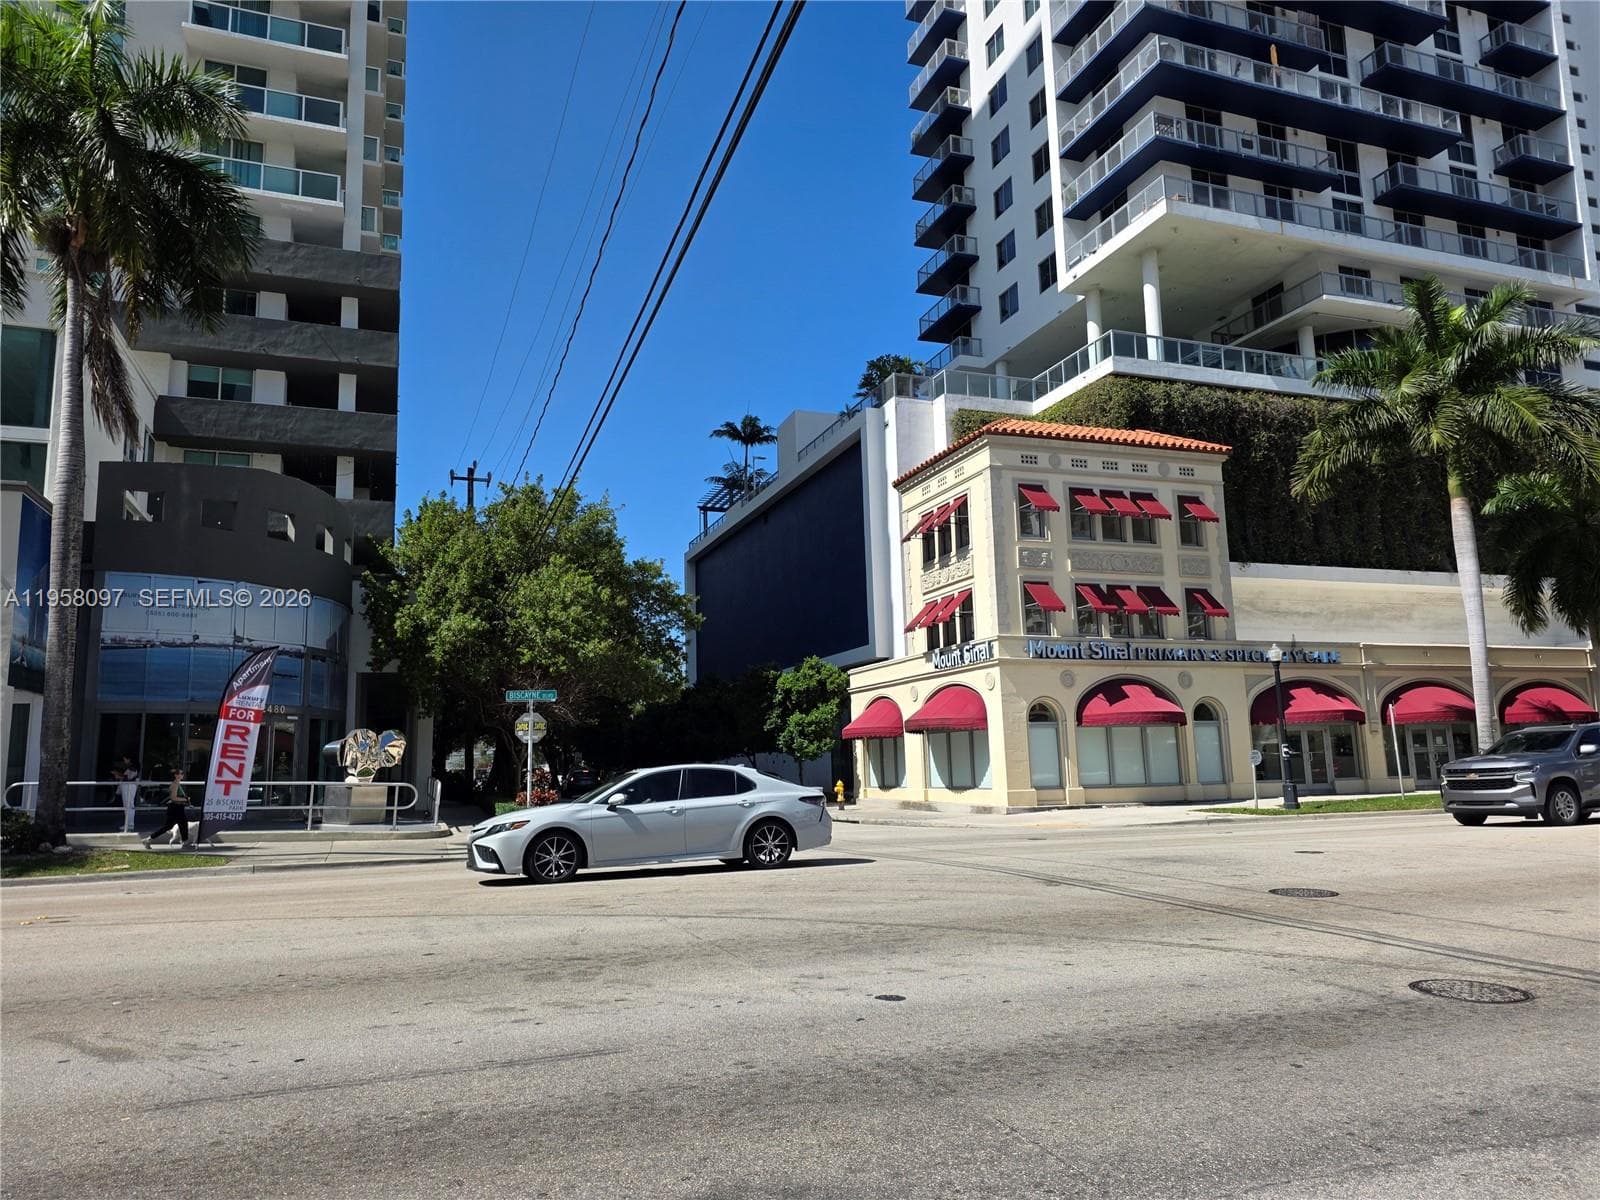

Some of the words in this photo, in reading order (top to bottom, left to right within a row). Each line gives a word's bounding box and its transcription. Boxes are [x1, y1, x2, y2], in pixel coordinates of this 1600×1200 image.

[1028, 640, 1086, 659] Mount
[1137, 647, 1208, 661] PRIMARY
[1210, 649, 1223, 662] &
[932, 648, 961, 669] Mount
[237, 695, 265, 704] Luxury
[509, 691, 541, 699] BISCAYNE
[228, 708, 256, 720] FOR
[263, 704, 286, 714] 480
[214, 724, 251, 796] RENT
